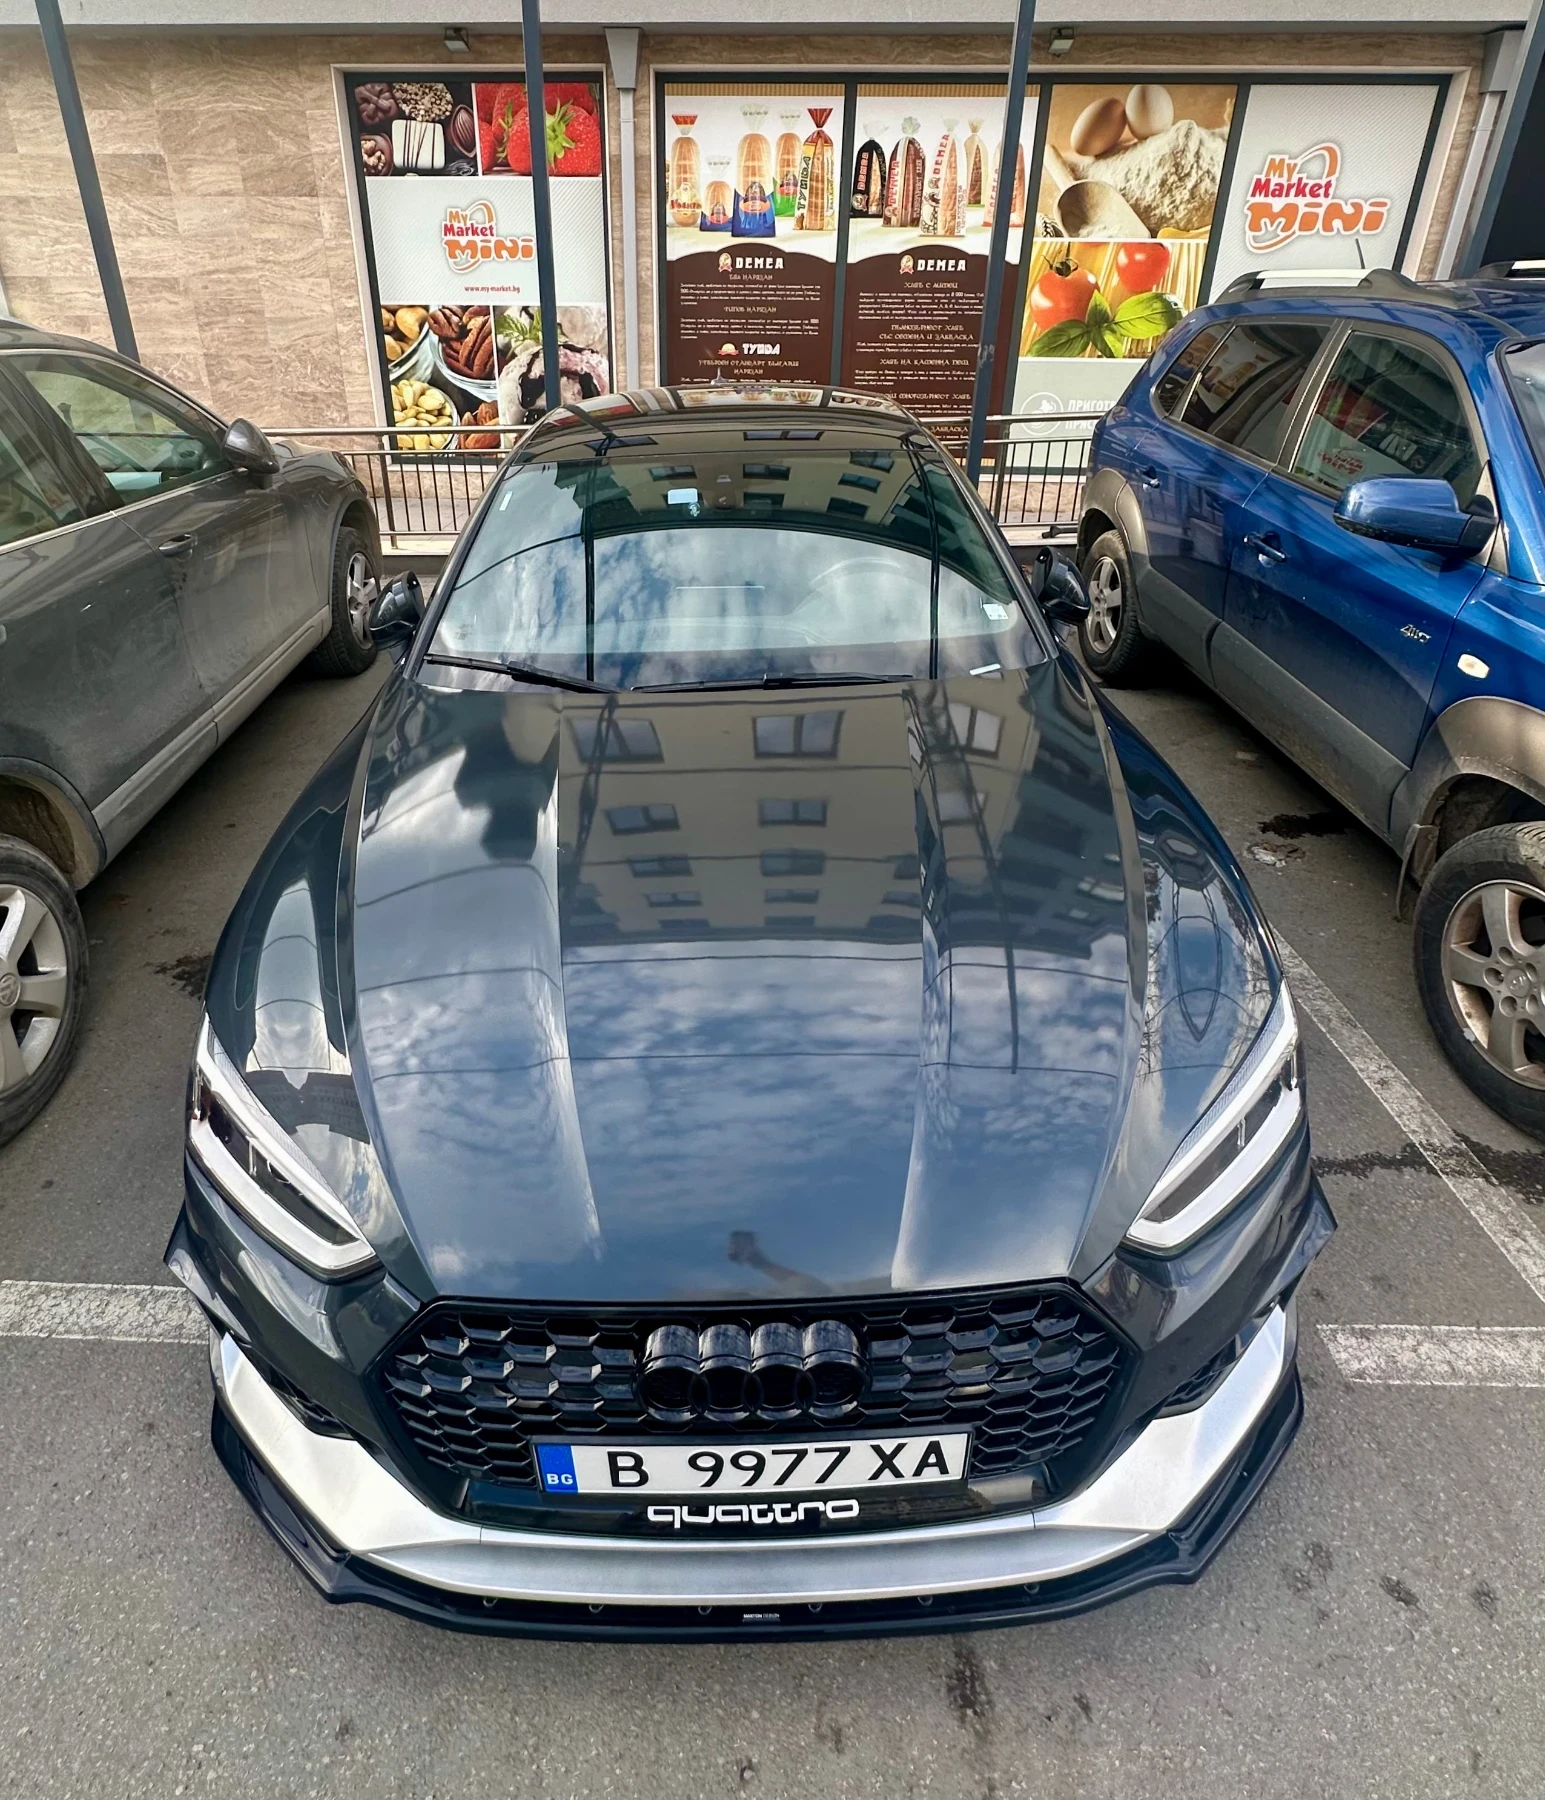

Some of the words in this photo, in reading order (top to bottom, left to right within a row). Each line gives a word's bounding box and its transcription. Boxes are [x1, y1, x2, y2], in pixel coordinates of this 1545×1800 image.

[1264, 158, 1298, 182] My
[1250, 177, 1332, 198] Market
[448, 210, 468, 226] My
[444, 222, 494, 237] Market
[607, 1450, 650, 1488] B
[687, 1446, 851, 1487] 9977
[868, 1440, 950, 1480] XA
[546, 1473, 574, 1485] BG
[647, 1498, 859, 1528] quattro
